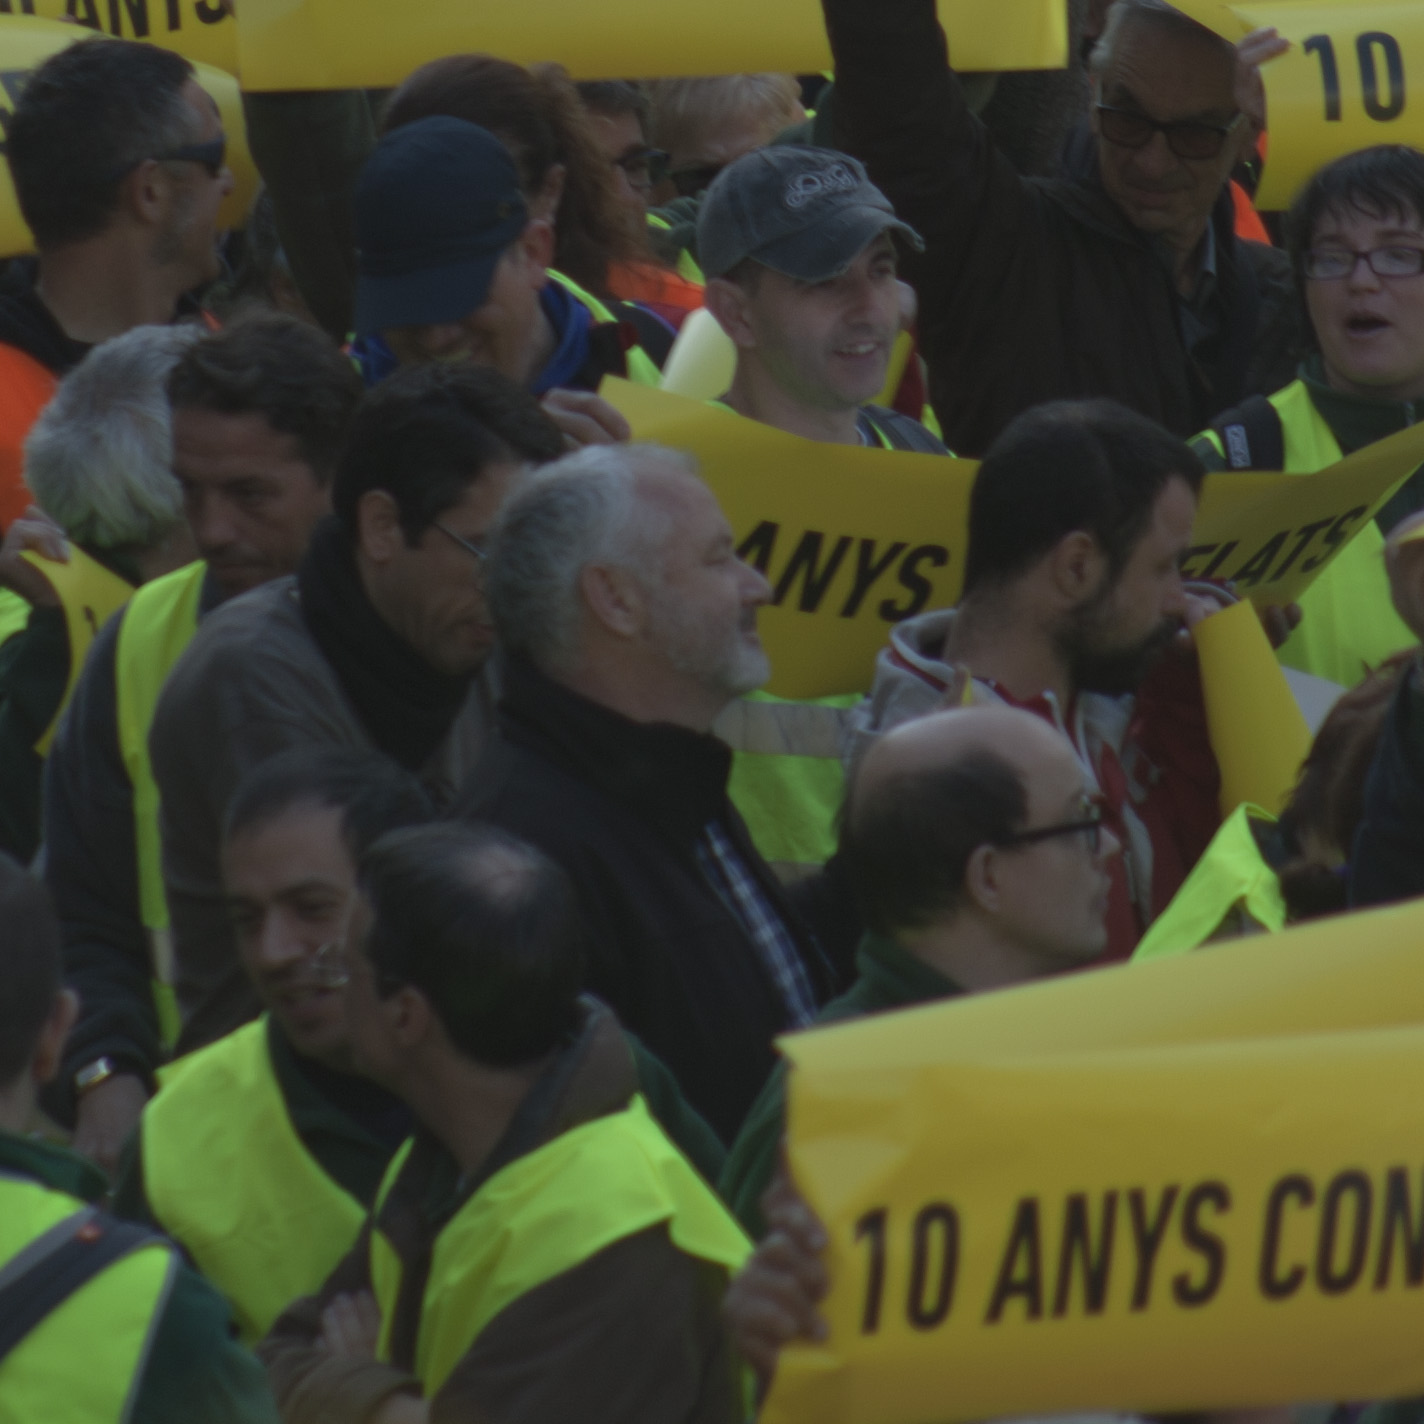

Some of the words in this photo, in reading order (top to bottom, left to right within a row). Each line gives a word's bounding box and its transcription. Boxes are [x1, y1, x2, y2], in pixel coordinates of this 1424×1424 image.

[1302, 30, 1407, 122] 10
[853, 1201, 963, 1337] 10
[983, 1176, 1232, 1328] ANYS
